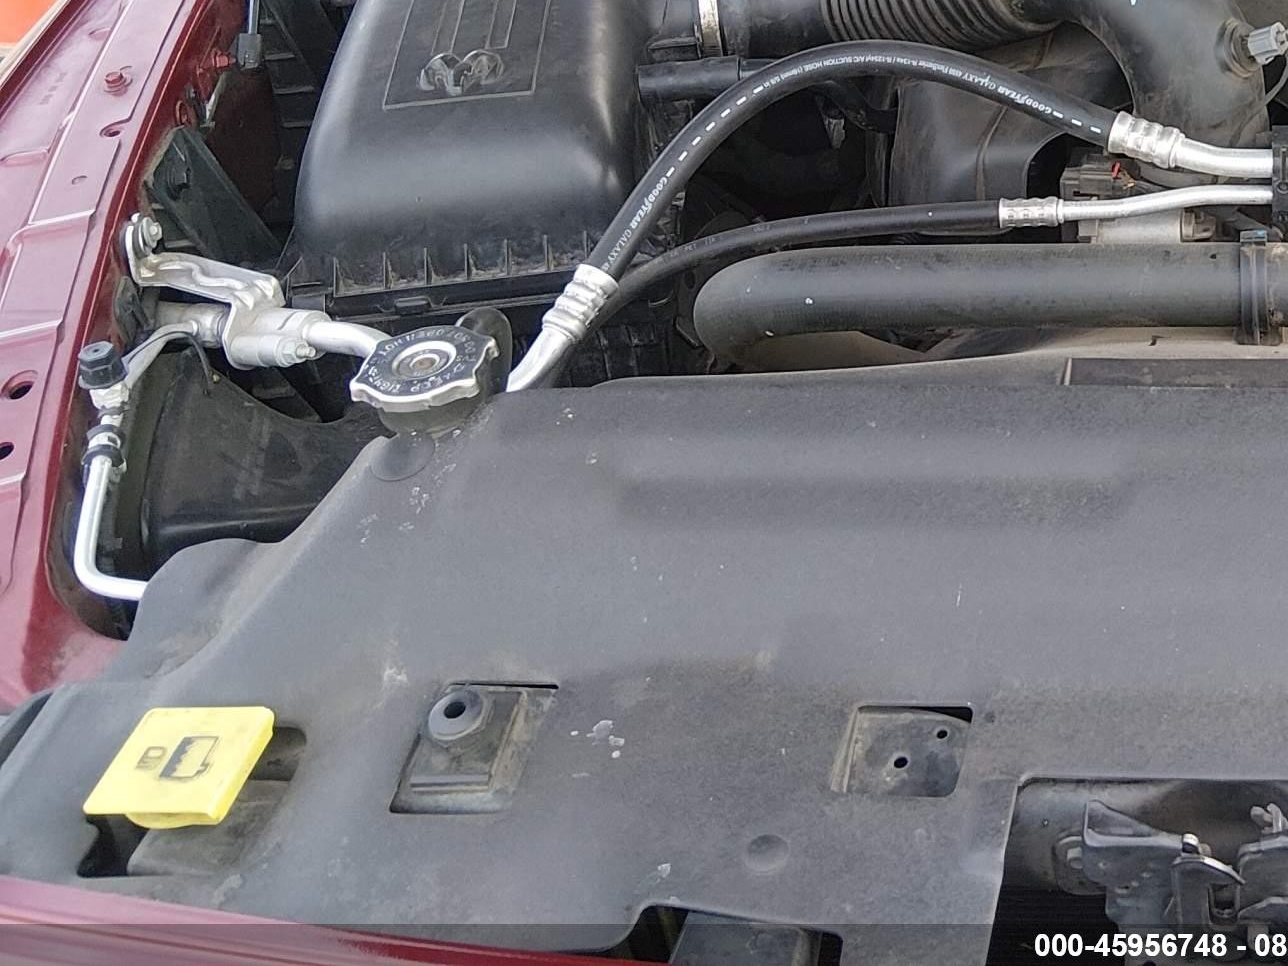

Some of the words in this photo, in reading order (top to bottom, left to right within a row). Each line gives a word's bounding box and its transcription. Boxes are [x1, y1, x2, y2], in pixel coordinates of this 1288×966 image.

[803, 60, 823, 73] HOSE
[823, 55, 853, 67] SUCTION
[853, 55, 865, 64] A/C
[962, 71, 997, 91] GALAXY
[997, 85, 1052, 114] GOODYEAR
[631, 176, 668, 229] GOODYEAR
[607, 228, 633, 265] GALAXY
